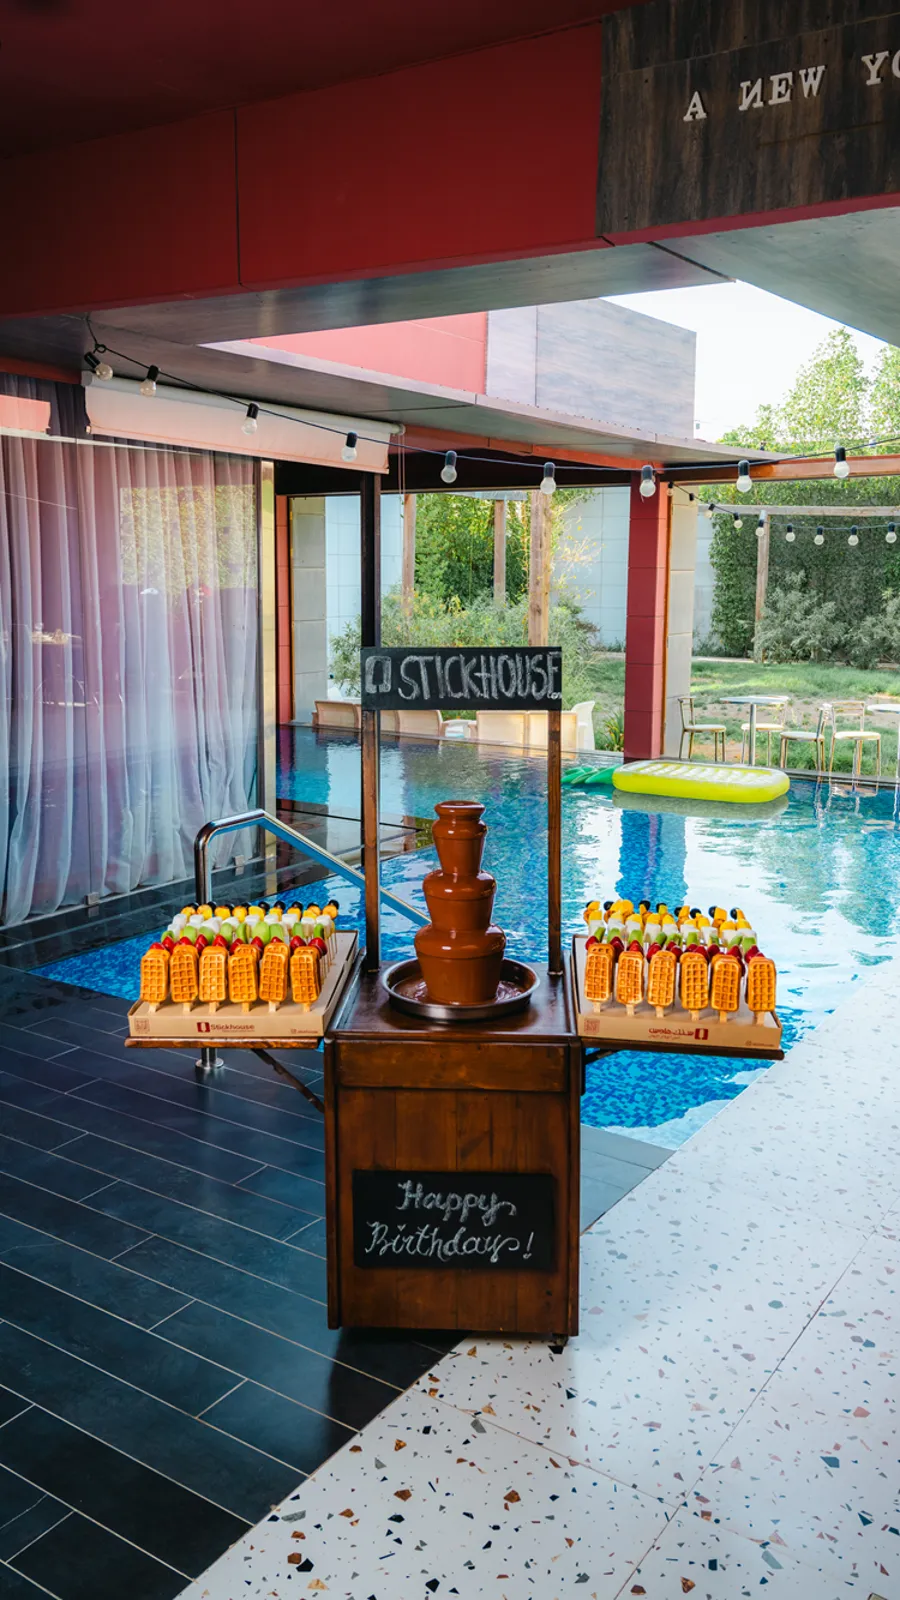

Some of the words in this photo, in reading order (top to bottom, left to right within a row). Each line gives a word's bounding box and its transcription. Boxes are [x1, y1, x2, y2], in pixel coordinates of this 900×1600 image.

[683, 91, 708, 122] A
[398, 651, 562, 700] STICKHOUSE
[395, 1179, 517, 1227] Happy
